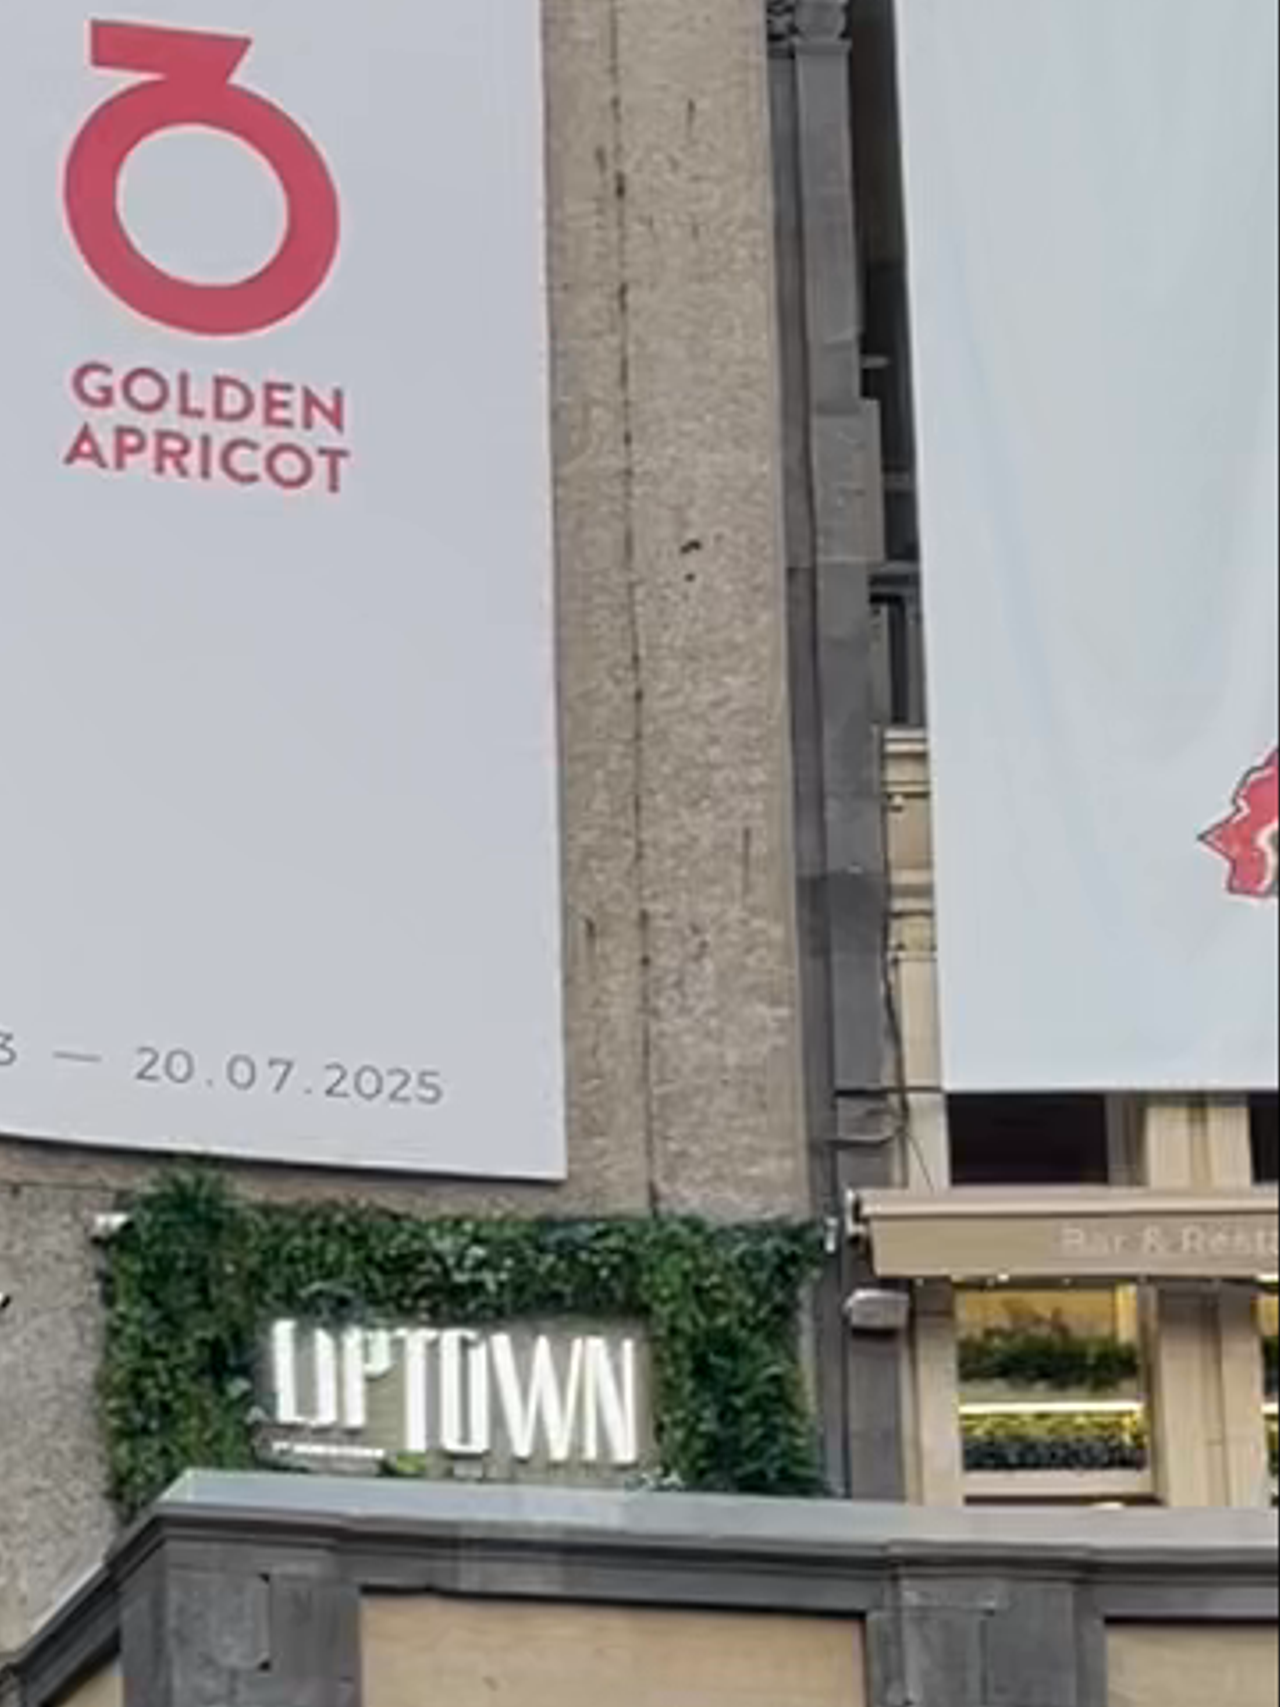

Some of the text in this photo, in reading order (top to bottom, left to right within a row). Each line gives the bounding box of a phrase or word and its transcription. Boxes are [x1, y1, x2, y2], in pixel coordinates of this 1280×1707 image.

[70, 362, 345, 433] GOLDEN
[62, 422, 349, 493] APRICOT
[271, 1318, 637, 1465] UPTOWN
